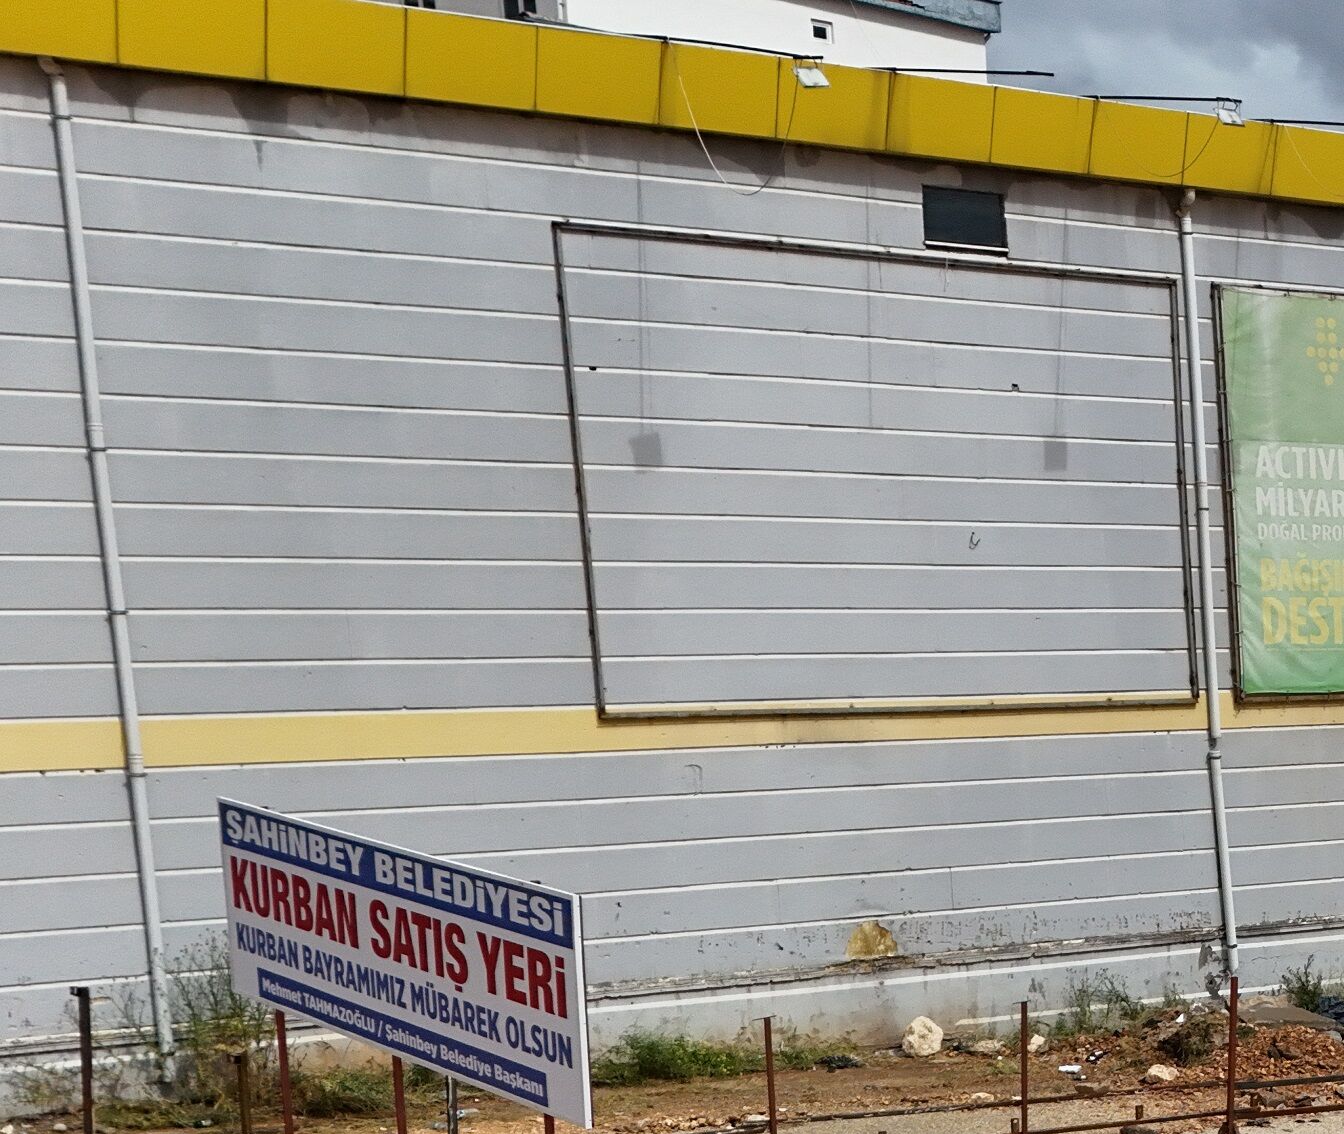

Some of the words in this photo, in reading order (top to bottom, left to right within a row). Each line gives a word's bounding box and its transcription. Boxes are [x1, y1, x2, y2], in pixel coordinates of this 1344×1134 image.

[1258, 521, 1308, 541] DOĞAL
[226, 810, 364, 876] ŞAHİNBEY
[374, 852, 564, 936] BELEDİYESİ
[230, 855, 360, 949] KURBAN
[369, 900, 468, 992] SATIŞ
[476, 930, 568, 1020] YERİ
[236, 922, 300, 970] KURBAN
[302, 942, 408, 1009] BAYRAMIMIZ
[410, 980, 502, 1044] MÜBAREK
[505, 1016, 574, 1069] OLSUN
[262, 978, 302, 1005] Mehmet
[302, 992, 376, 1036] TAHMAZOĞLU
[386, 1023, 440, 1060] Şahinbey
[440, 1044, 492, 1078] Belediye
[494, 1064, 544, 1098] Başkanı
